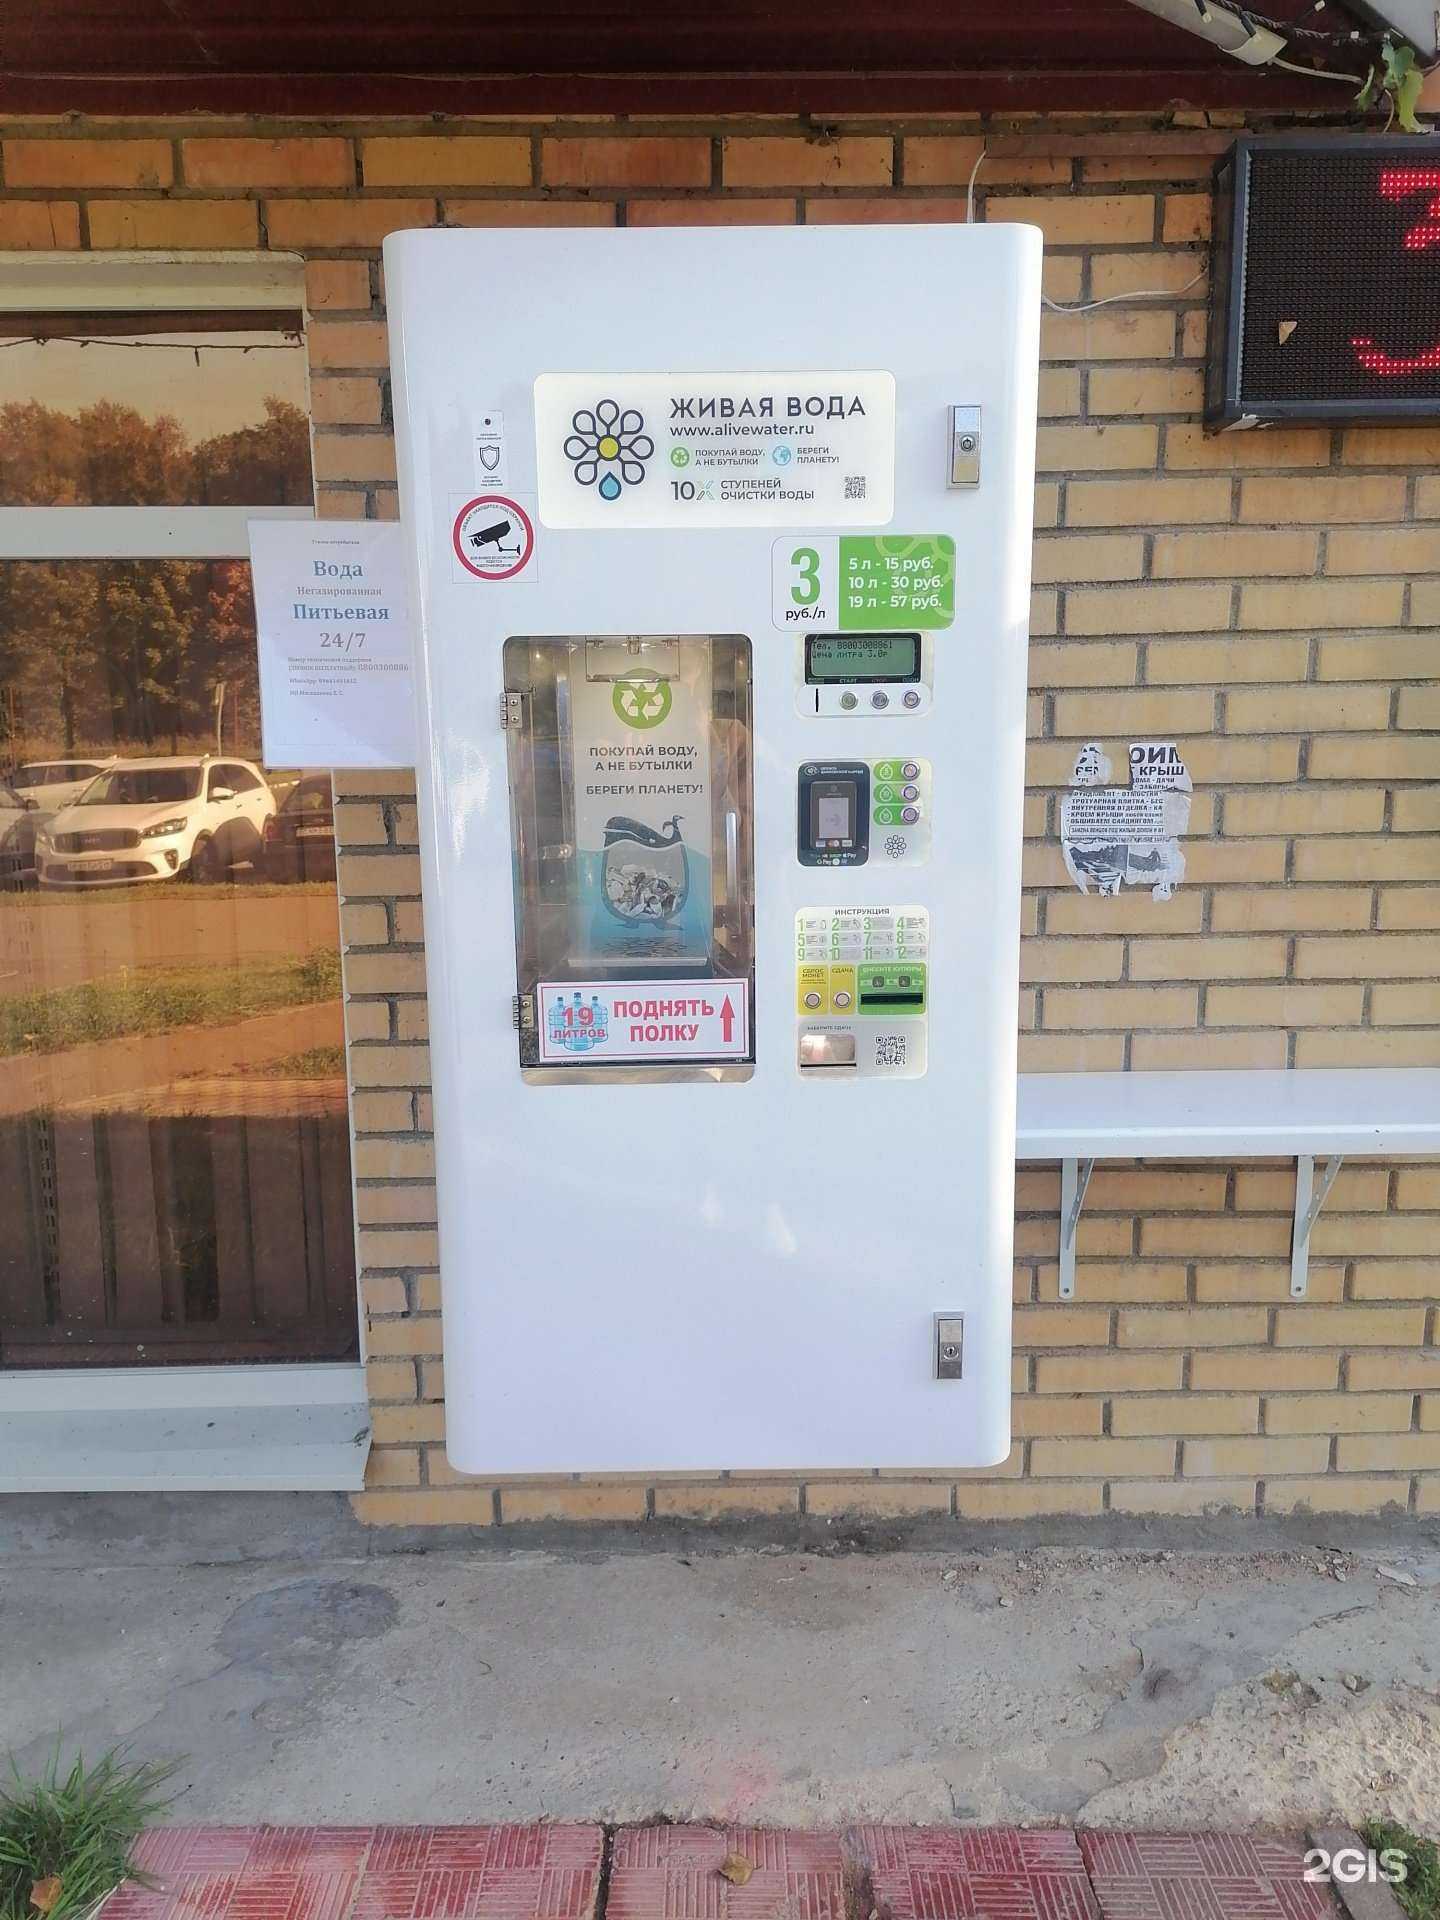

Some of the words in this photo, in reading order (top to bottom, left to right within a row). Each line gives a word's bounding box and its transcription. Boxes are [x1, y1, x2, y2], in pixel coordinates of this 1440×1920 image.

[670, 397, 774, 419] ЖИВАЯ
[787, 395, 866, 420] ВОДА
[669, 423, 815, 436] www.alivewater.ru
[695, 448, 738, 458] ПОКУПАЙ
[740, 448, 766, 457] ВОДУ,
[796, 447, 830, 455] БЕРЕГИ
[717, 458, 759, 466] БУТЫЛКИ
[796, 455, 840, 464] ПЛАНЕТУ!
[720, 477, 782, 489] СТУПЕНЕЙ
[720, 490, 776, 501] ОЧИСТКИ
[779, 490, 815, 501] ВОДЫ
[313, 560, 364, 580] Вода
[848, 558, 858, 570] 5
[861, 560, 871, 570] л
[884, 557, 899, 570] 15
[903, 556, 934, 573] руб.
[790, 547, 821, 606] 3
[848, 576, 864, 589] 10
[867, 579, 878, 589] л
[891, 576, 909, 588] 30
[913, 574, 944, 591] руб.
[297, 586, 382, 598] Негазированная
[848, 596, 864, 608] 19
[867, 598, 877, 608] л
[890, 595, 907, 607] 57
[911, 593, 942, 610] руб.
[293, 603, 390, 620] Питьевая
[785, 606, 826, 621] руб./л
[319, 632, 366, 653] 24/7
[812, 641, 831, 650] Тел.
[589, 744, 654, 757] ПОКУПАЙ
[658, 746, 698, 758] ВОДУ,
[595, 761, 605, 771] А
[608, 761, 625, 771] НЕ
[629, 760, 693, 771] БУТЫЛКИ
[1139, 766, 1184, 776] КРЫШ
[586, 785, 635, 795] БЕРЕГИ
[638, 784, 703, 795] ПЛАНЕТУ!
[834, 907, 890, 916] ИНСТРУКЦИЯ
[797, 919, 804, 931] 1
[831, 918, 840, 931] 2
[863, 917, 872, 930] 3
[896, 917, 905, 929] 4
[798, 932, 805, 946] 5
[831, 932, 839, 945] 6
[863, 931, 872, 945] 7
[896, 931, 905, 944] 8
[798, 947, 805, 961] 9
[829, 947, 840, 960] 10
[863, 947, 873, 960] 11
[895, 946, 906, 960] 12
[563, 1007, 594, 1026] 19
[613, 999, 715, 1020] ПОДНЯТЬ
[553, 1029, 606, 1040] ЛИТРОВ
[630, 1024, 700, 1042] ПОЛКУ
